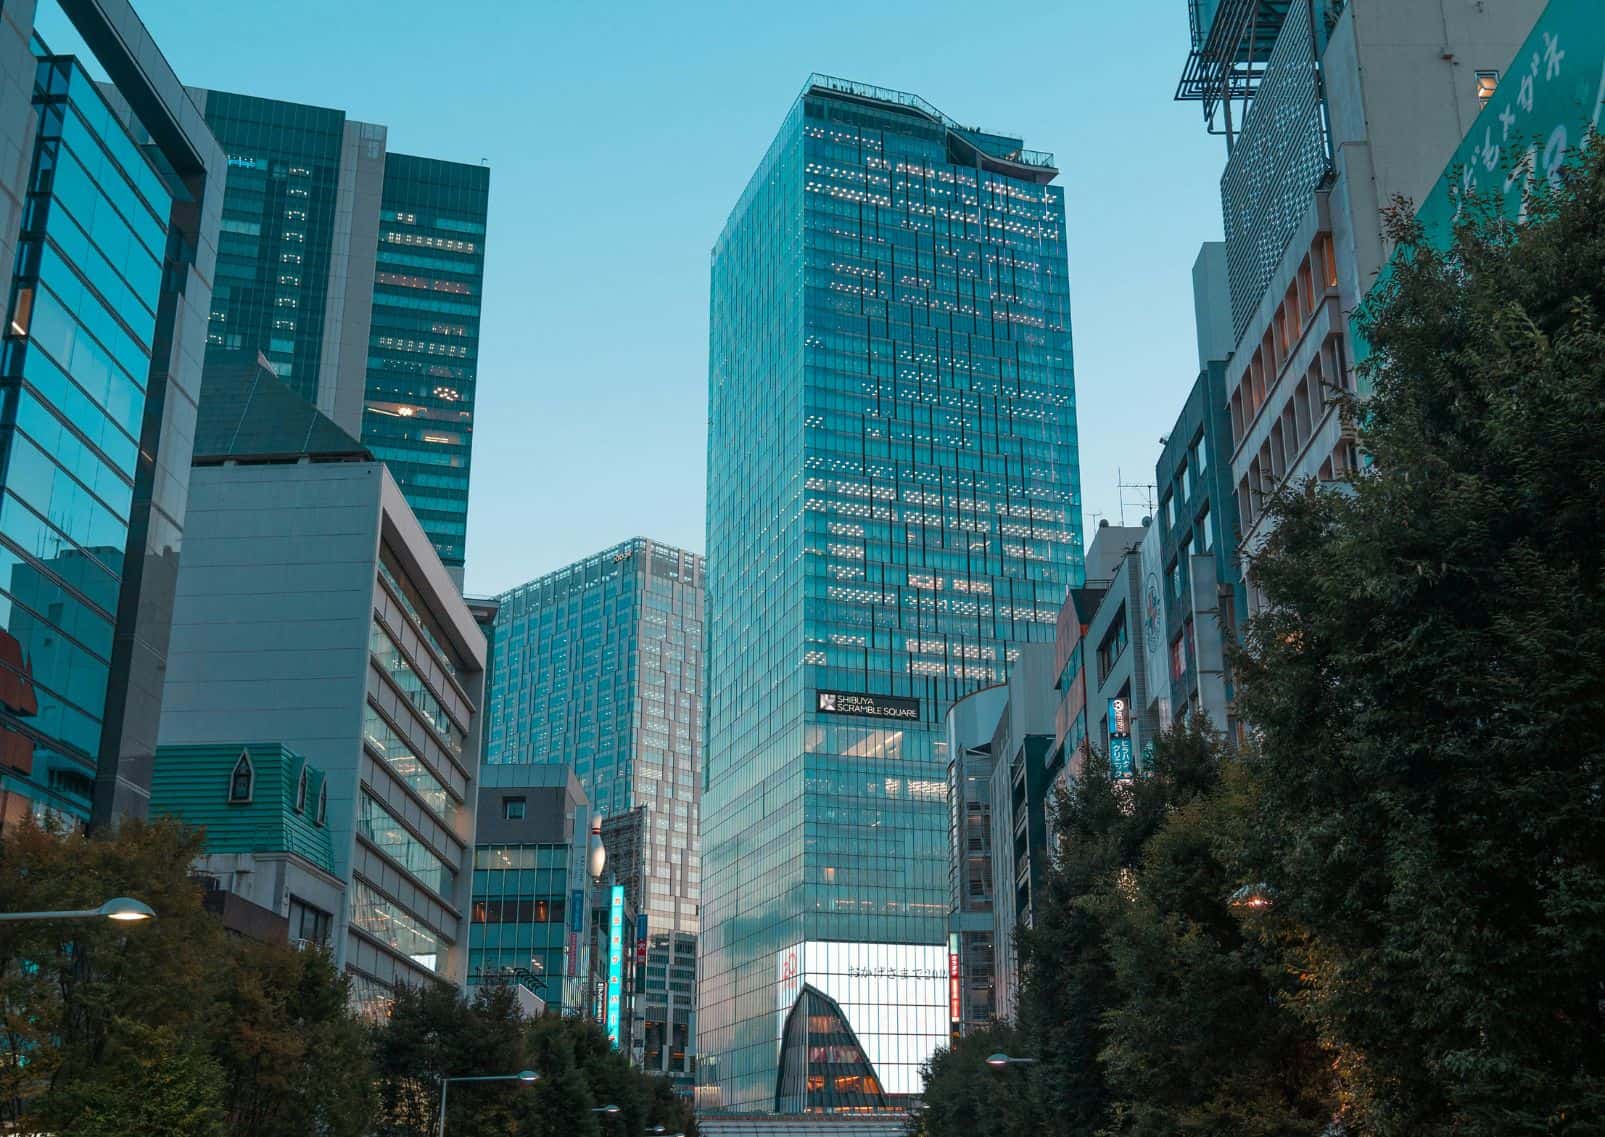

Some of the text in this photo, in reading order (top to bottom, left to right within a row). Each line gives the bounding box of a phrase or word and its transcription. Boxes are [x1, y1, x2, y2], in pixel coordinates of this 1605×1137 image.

[837, 695, 875, 705] SHIBUYA
[837, 704, 917, 718] SCRAMBLE SQUARE
